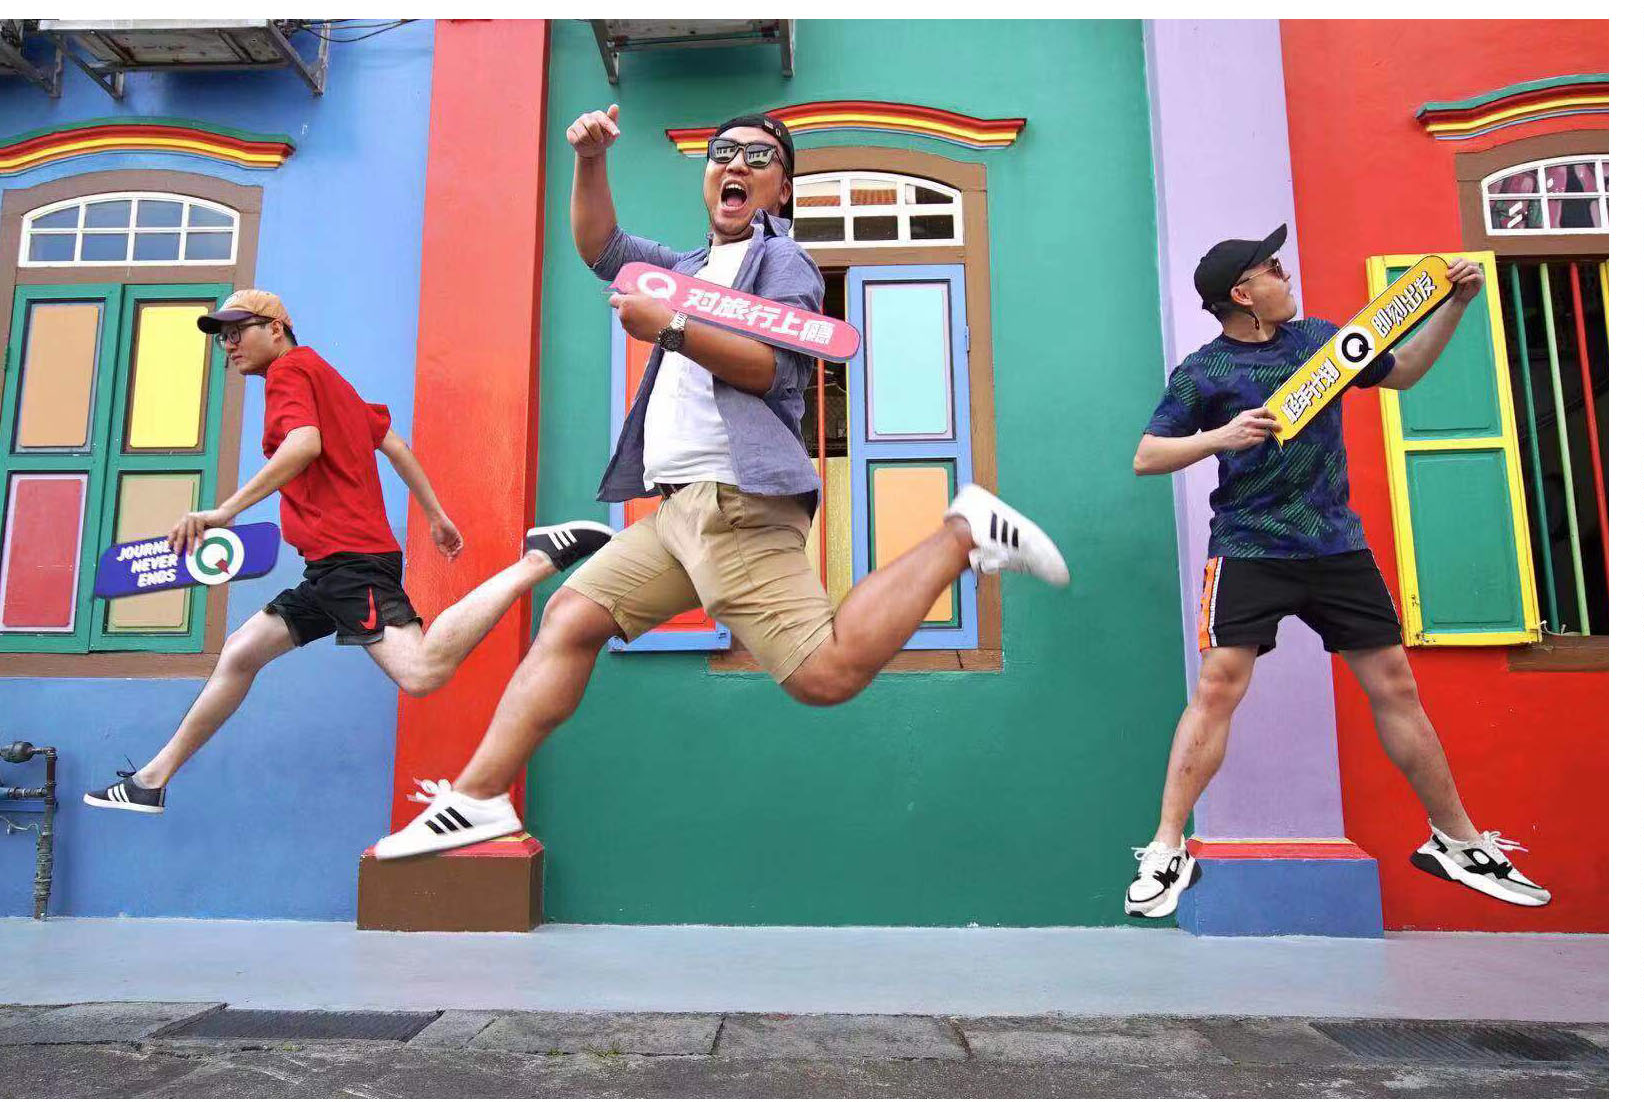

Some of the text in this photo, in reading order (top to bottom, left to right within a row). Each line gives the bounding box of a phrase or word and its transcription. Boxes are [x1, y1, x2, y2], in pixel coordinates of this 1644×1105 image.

[1370, 271, 1437, 338] 即刻出发
[683, 288, 836, 346] 对旅行上瘾
[117, 540, 172, 561] JOURNE
[131, 554, 178, 574] NEVER
[137, 568, 176, 587] ENDS
